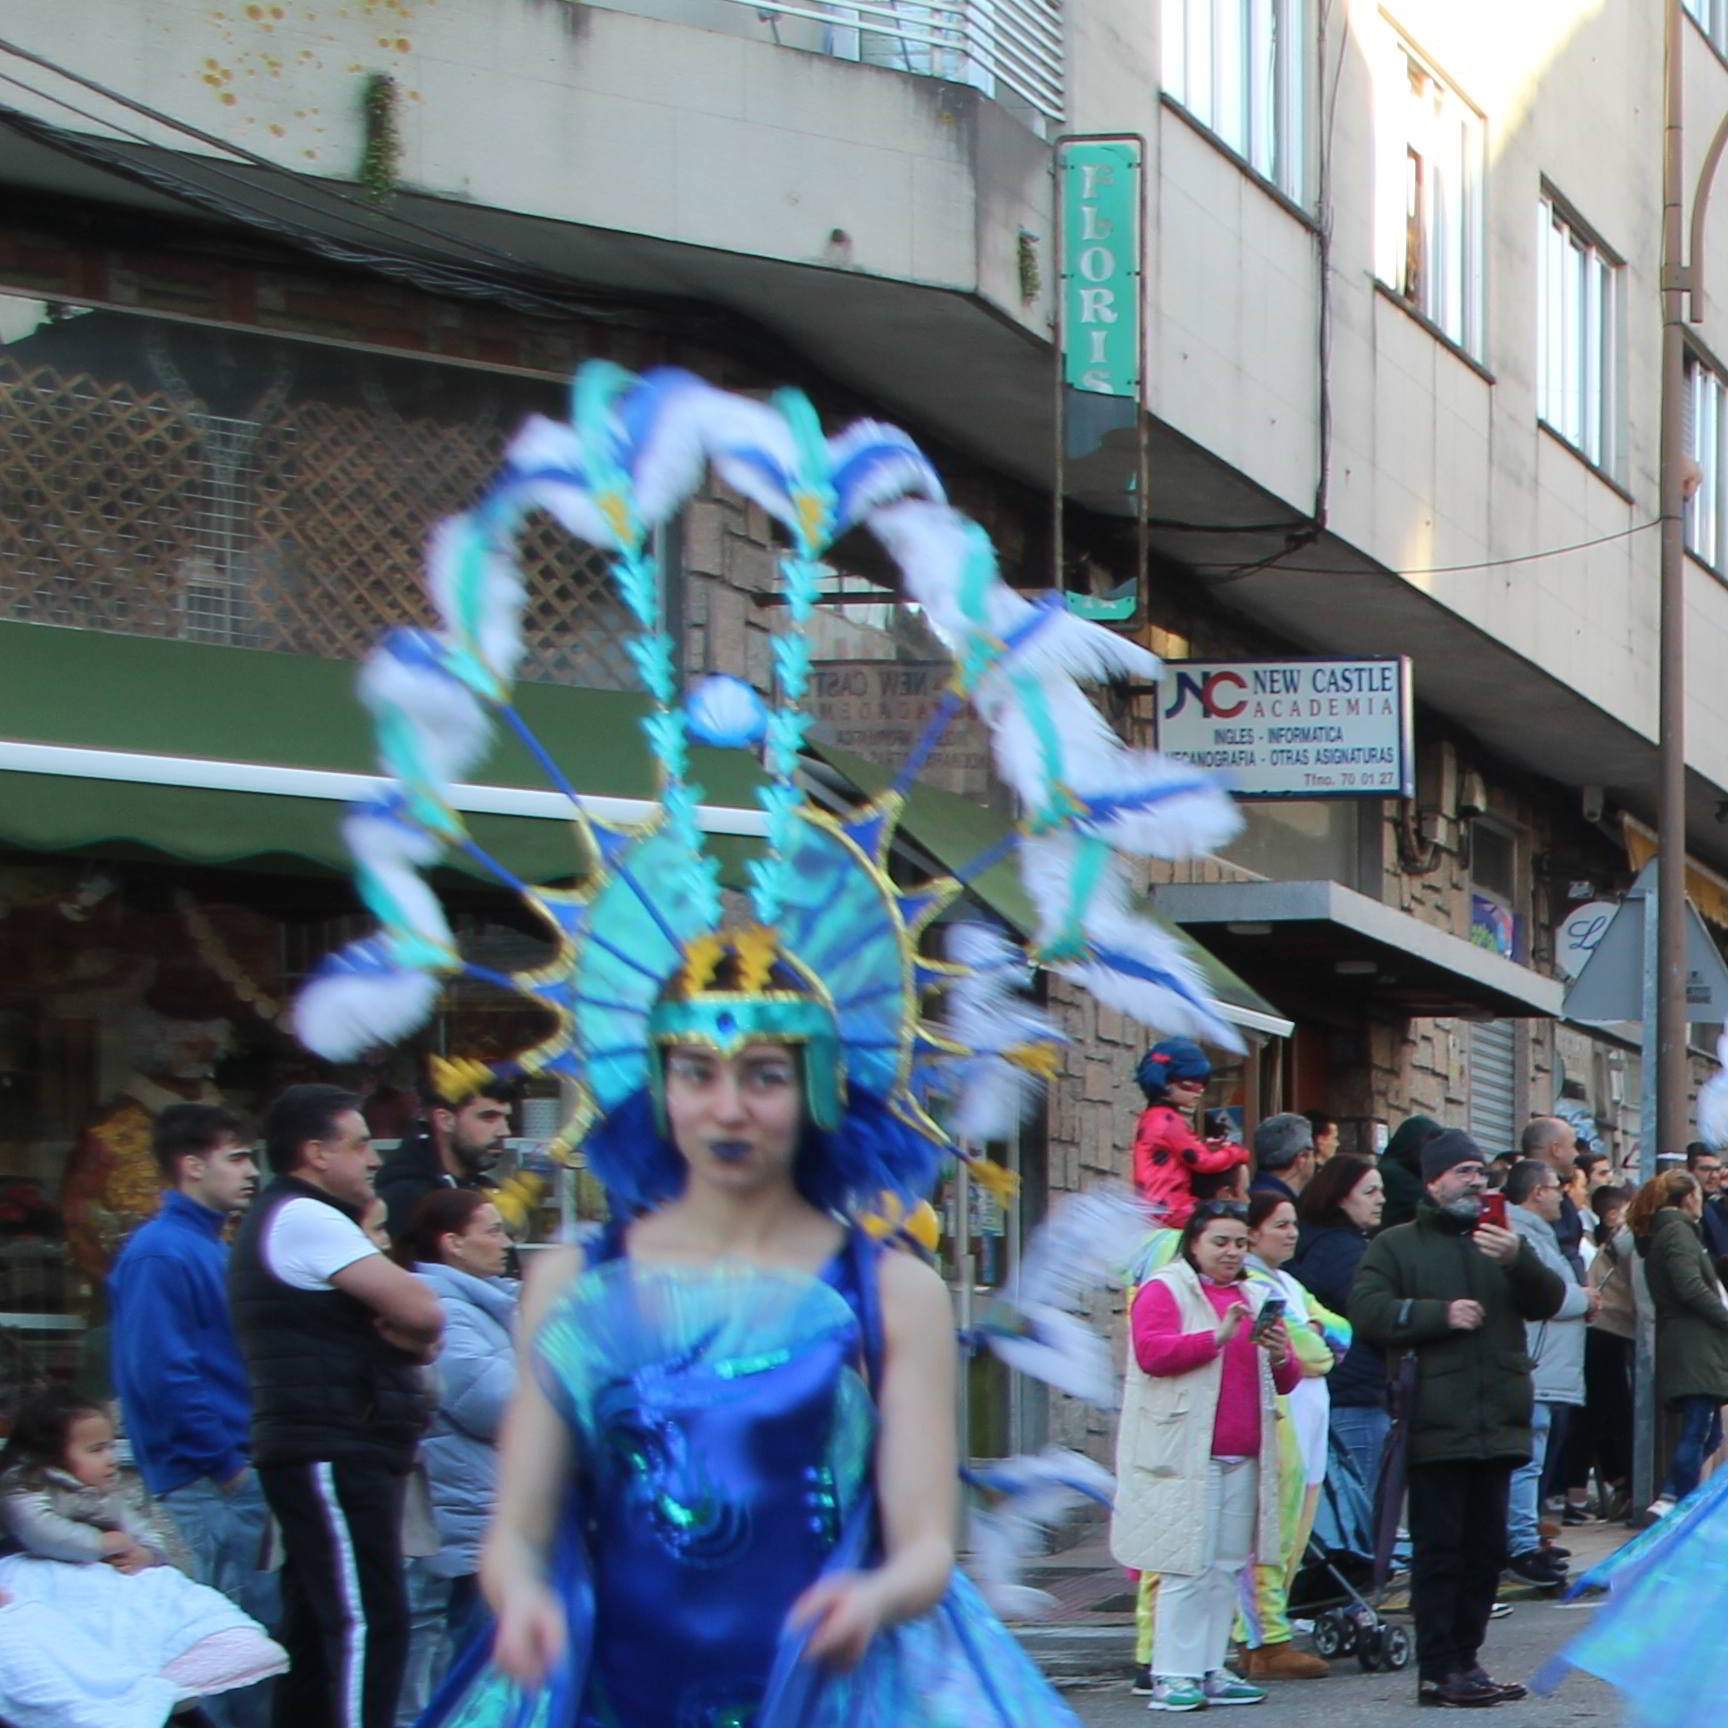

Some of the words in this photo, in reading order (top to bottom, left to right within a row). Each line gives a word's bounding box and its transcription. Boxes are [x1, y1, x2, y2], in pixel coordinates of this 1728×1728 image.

[1253, 669, 1301, 695] NEW
[1312, 667, 1394, 693] CASTLE
[1165, 670, 1248, 719] NC
[1253, 698, 1394, 718] ACADEMIA
[1214, 727, 1254, 745] INGLES
[1268, 726, 1344, 744] INFORMATICA
[1270, 748, 1309, 767] OTRAS
[1314, 747, 1395, 766] ASIGNATURAS
